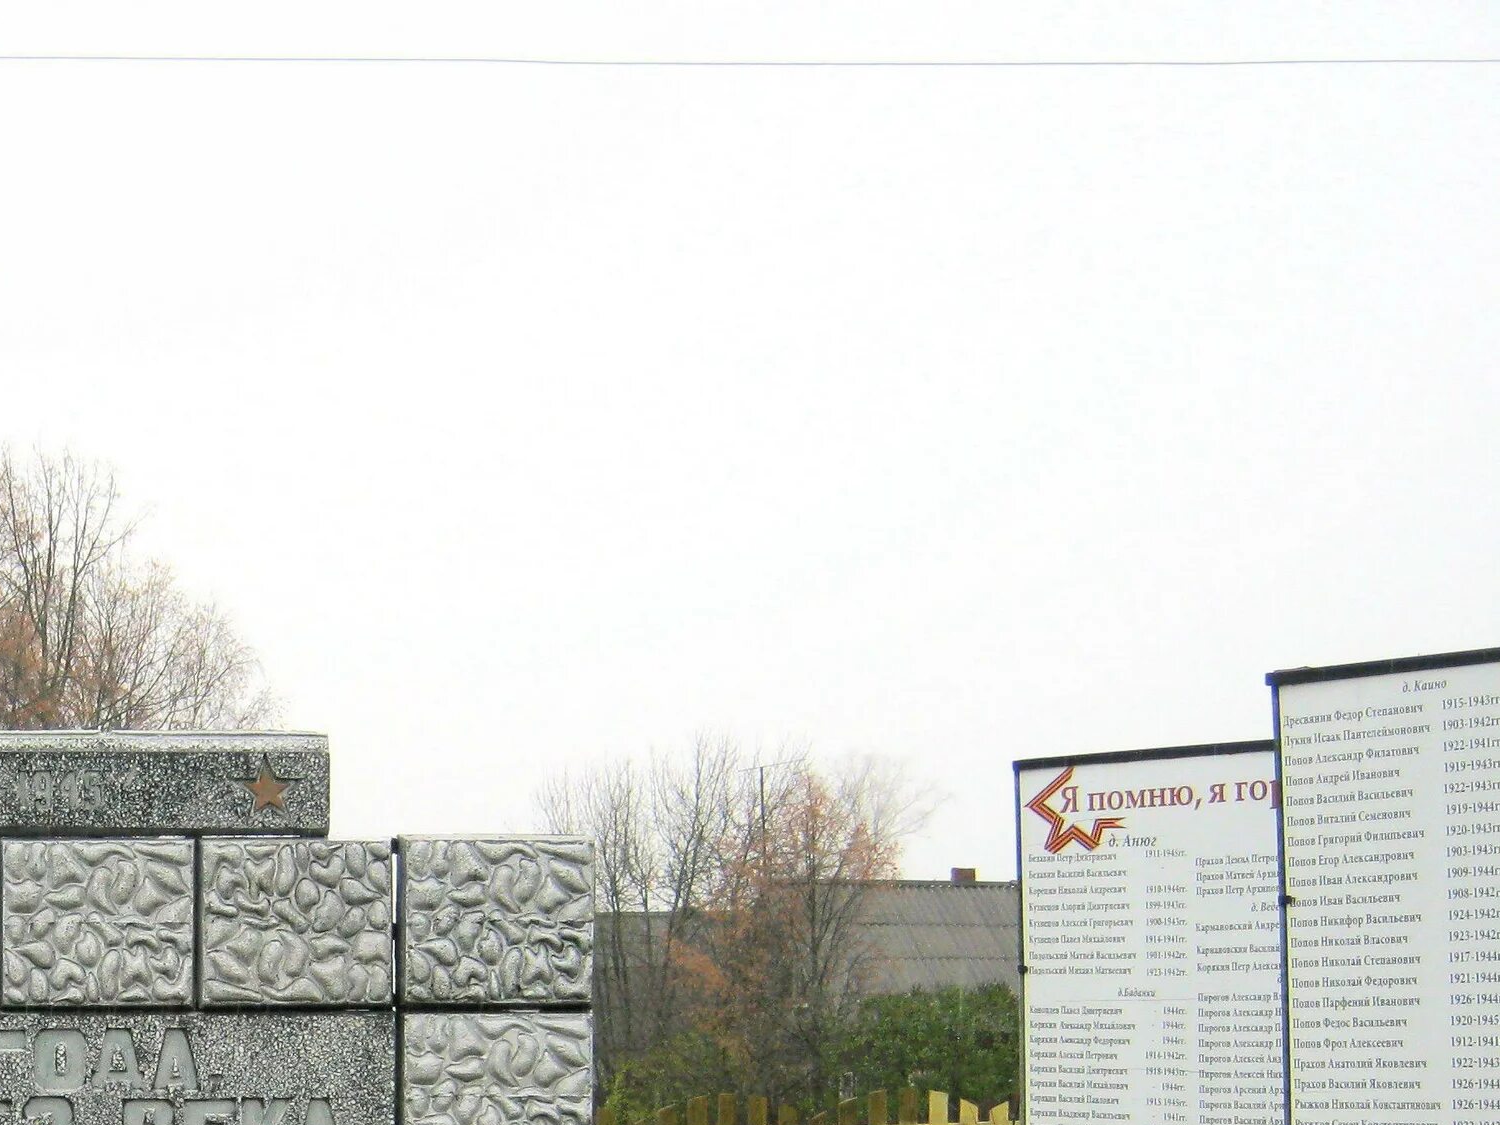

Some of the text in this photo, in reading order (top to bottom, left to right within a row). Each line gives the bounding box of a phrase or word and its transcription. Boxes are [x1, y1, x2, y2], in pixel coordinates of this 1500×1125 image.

[1352, 769, 1400, 781] Иванович
[1058, 784, 1079, 814] Я
[1087, 786, 1202, 811] помню,
[1208, 783, 1227, 804] я
